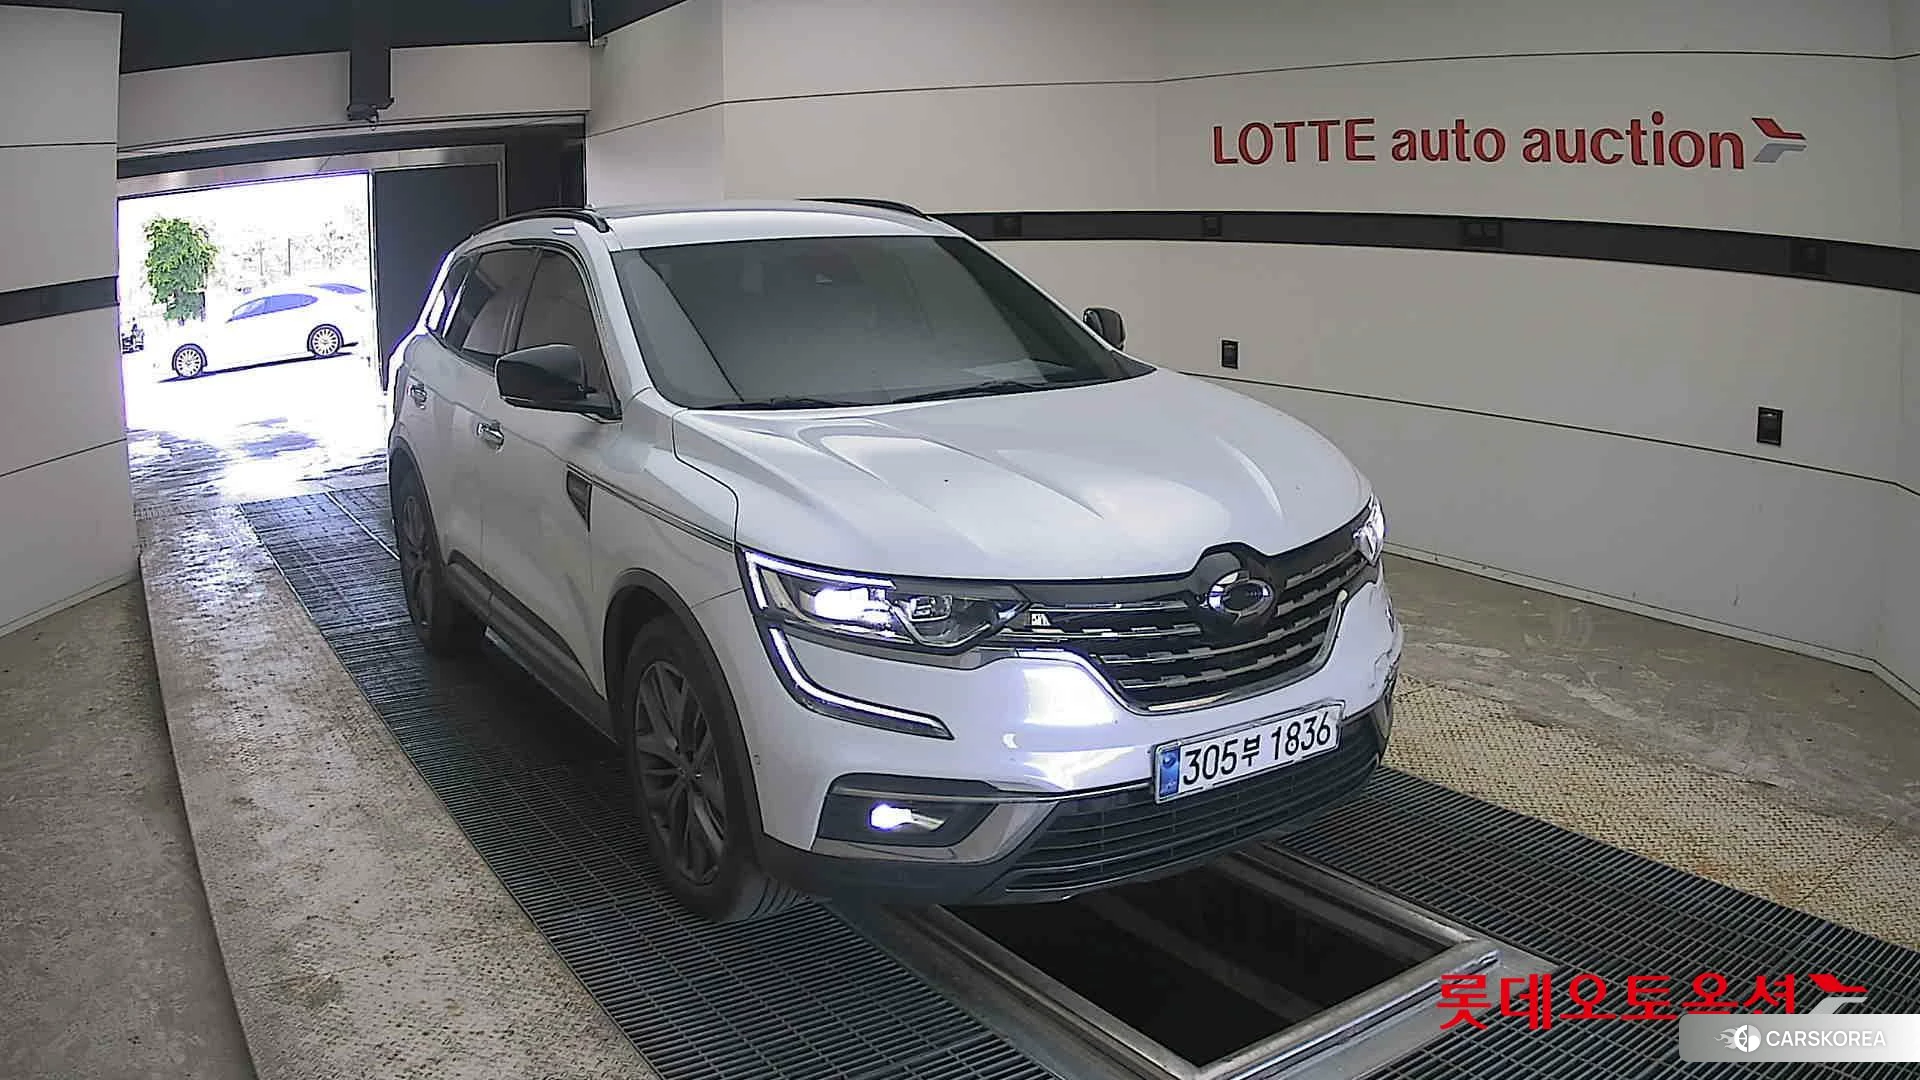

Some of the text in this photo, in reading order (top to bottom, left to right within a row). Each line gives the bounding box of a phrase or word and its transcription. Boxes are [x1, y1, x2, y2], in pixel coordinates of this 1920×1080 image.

[1212, 111, 1745, 170] LOTTE auto auction
[1271, 711, 1331, 761] 1836
